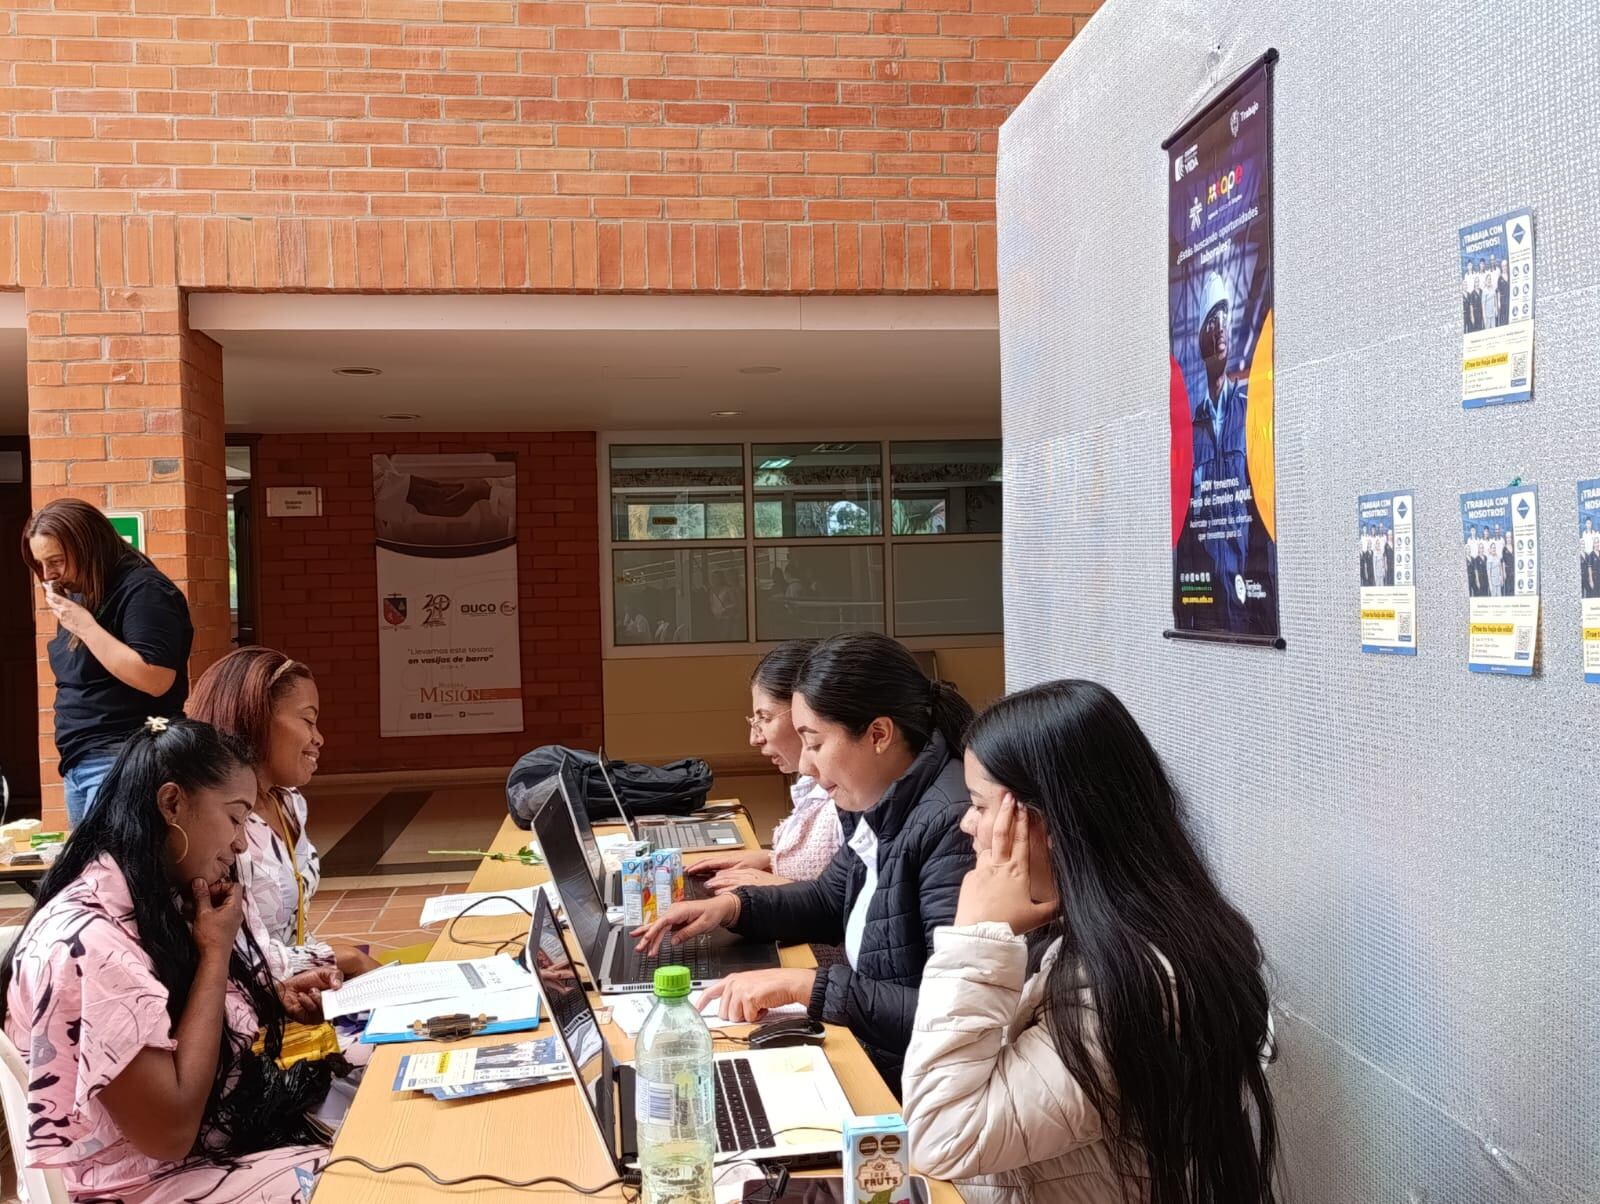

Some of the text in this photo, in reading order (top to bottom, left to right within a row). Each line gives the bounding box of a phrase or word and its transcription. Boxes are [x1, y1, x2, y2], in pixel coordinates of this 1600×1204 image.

[1240, 101, 1259, 121] Trabajo
[1193, 231, 1218, 253] buscando
[1219, 206, 1259, 238] oportunidades
[1489, 224, 1503, 236] CON
[1200, 238, 1232, 265] laborales?
[1200, 477, 1239, 492] HOY tenemos
[1204, 495, 1211, 506] de
[1212, 492, 1233, 507] Empleo
[1464, 496, 1508, 512] ¡TRABAJA CON
[1468, 507, 1505, 520] NOSOTROS!
[421, 656, 450, 664] vasijas
[453, 655, 463, 663] de
[864, 1176, 898, 1187] FRUTS
